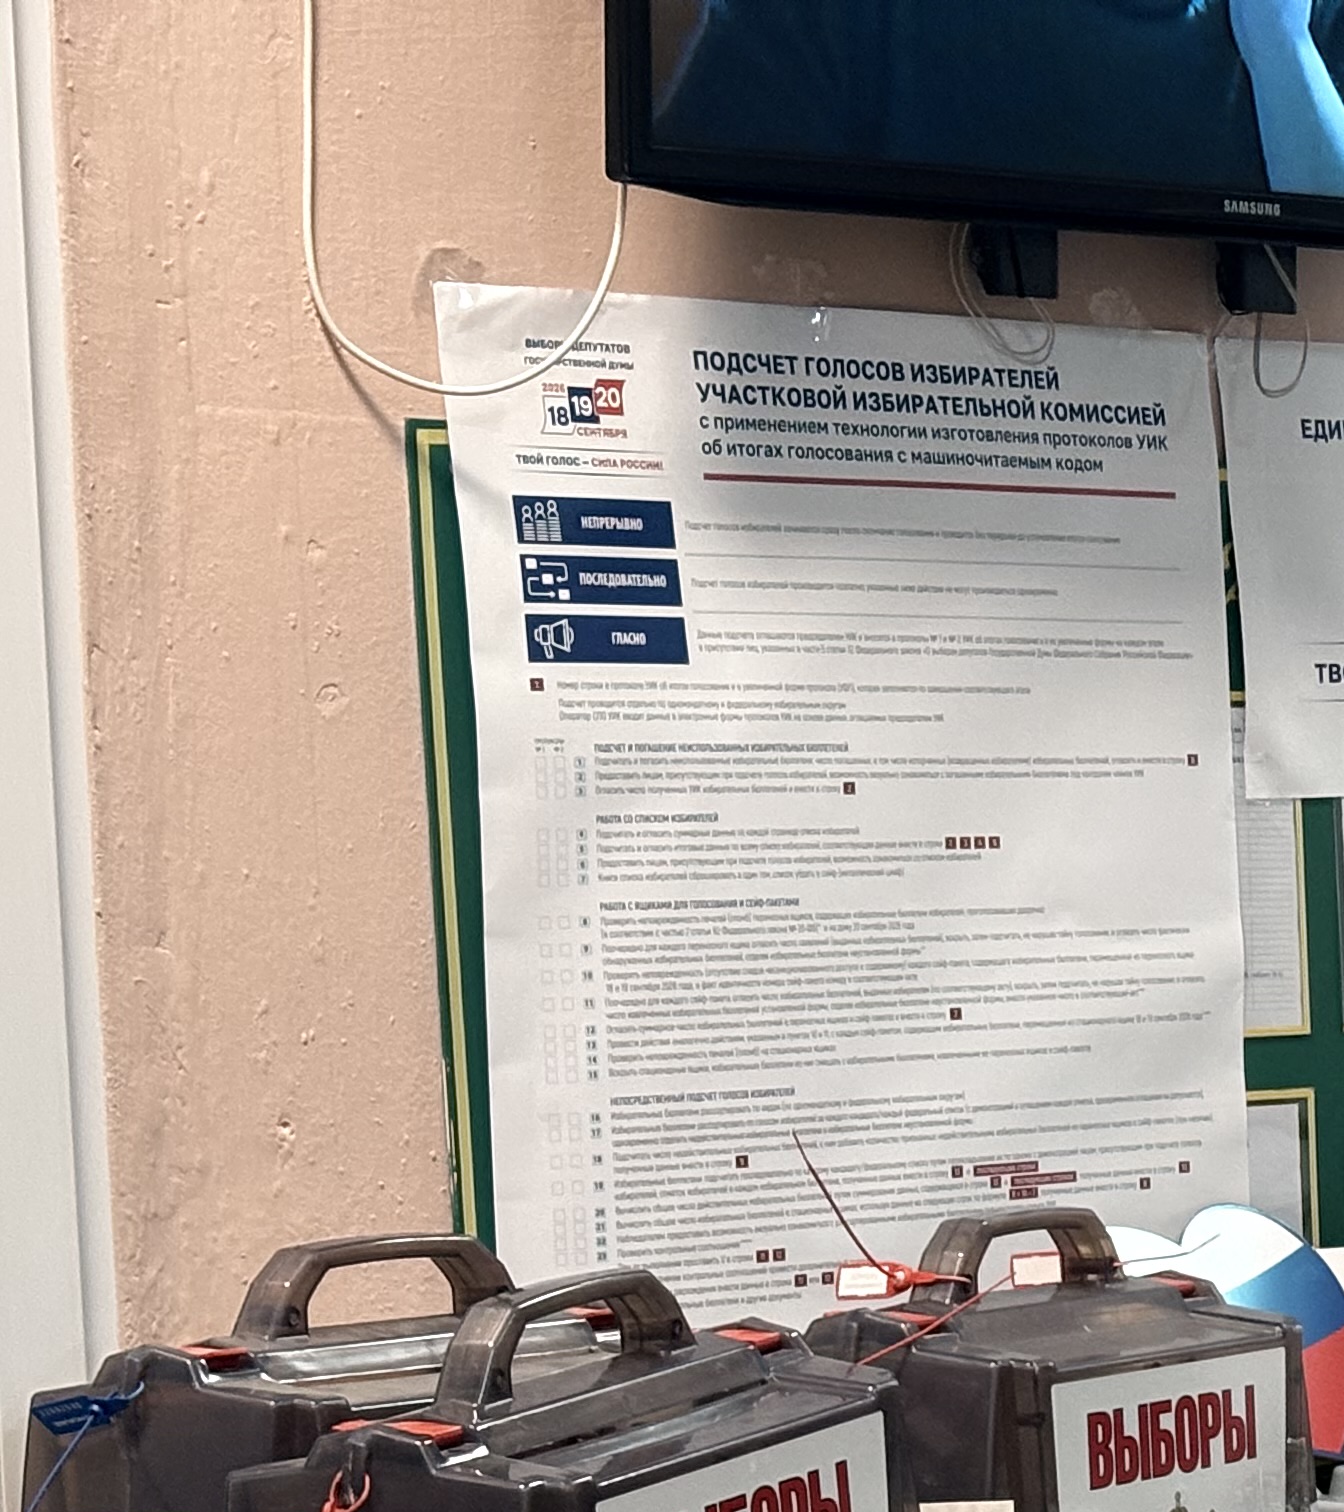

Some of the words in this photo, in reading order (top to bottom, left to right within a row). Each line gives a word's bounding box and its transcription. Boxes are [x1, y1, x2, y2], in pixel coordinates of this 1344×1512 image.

[1224, 199, 1281, 217] SAMSUNG
[693, 350, 798, 376] ПОДСЧЕТ
[804, 356, 906, 381] ГОЛОСОВ
[911, 363, 1060, 391] ИЗБИРАТЕЛЕЙ
[542, 382, 565, 393] 2026
[594, 386, 621, 408] 20
[571, 395, 592, 416] 19
[695, 382, 847, 410] УЧАСТКОВОЙ
[852, 391, 1035, 420] ИЗБИРАТЕЛЬНОЙ
[1041, 401, 1167, 427] КОМИССИЕЙ
[548, 406, 569, 426] 18
[577, 427, 628, 439] СЕНТЯБРЯ
[699, 415, 709, 429] с
[714, 416, 828, 435] применением
[833, 421, 928, 439] технологии
[931, 427, 1040, 445] изготовления
[1043, 433, 1133, 449] протоколов
[1136, 434, 1168, 451] УИК
[515, 453, 544, 465] ТВОЙ
[546, 456, 580, 467] ГОЛОС
[591, 458, 619, 469] СИЛА
[621, 459, 664, 471] РОССИИ!
[701, 438, 722, 456] об
[726, 442, 783, 459] итогах
[787, 445, 894, 463] голосования
[897, 450, 907, 463] с
[911, 450, 1052, 470] машиночитаемым
[1055, 457, 1104, 473] кодом
[581, 516, 643, 531] НЕПРЕРЫВНО
[579, 572, 667, 588] ПОСЛЕДОВАТЕЛЬНО
[611, 632, 647, 645] ГЛАСНО
[1087, 1384, 1258, 1491] ВЫБОРЫ
